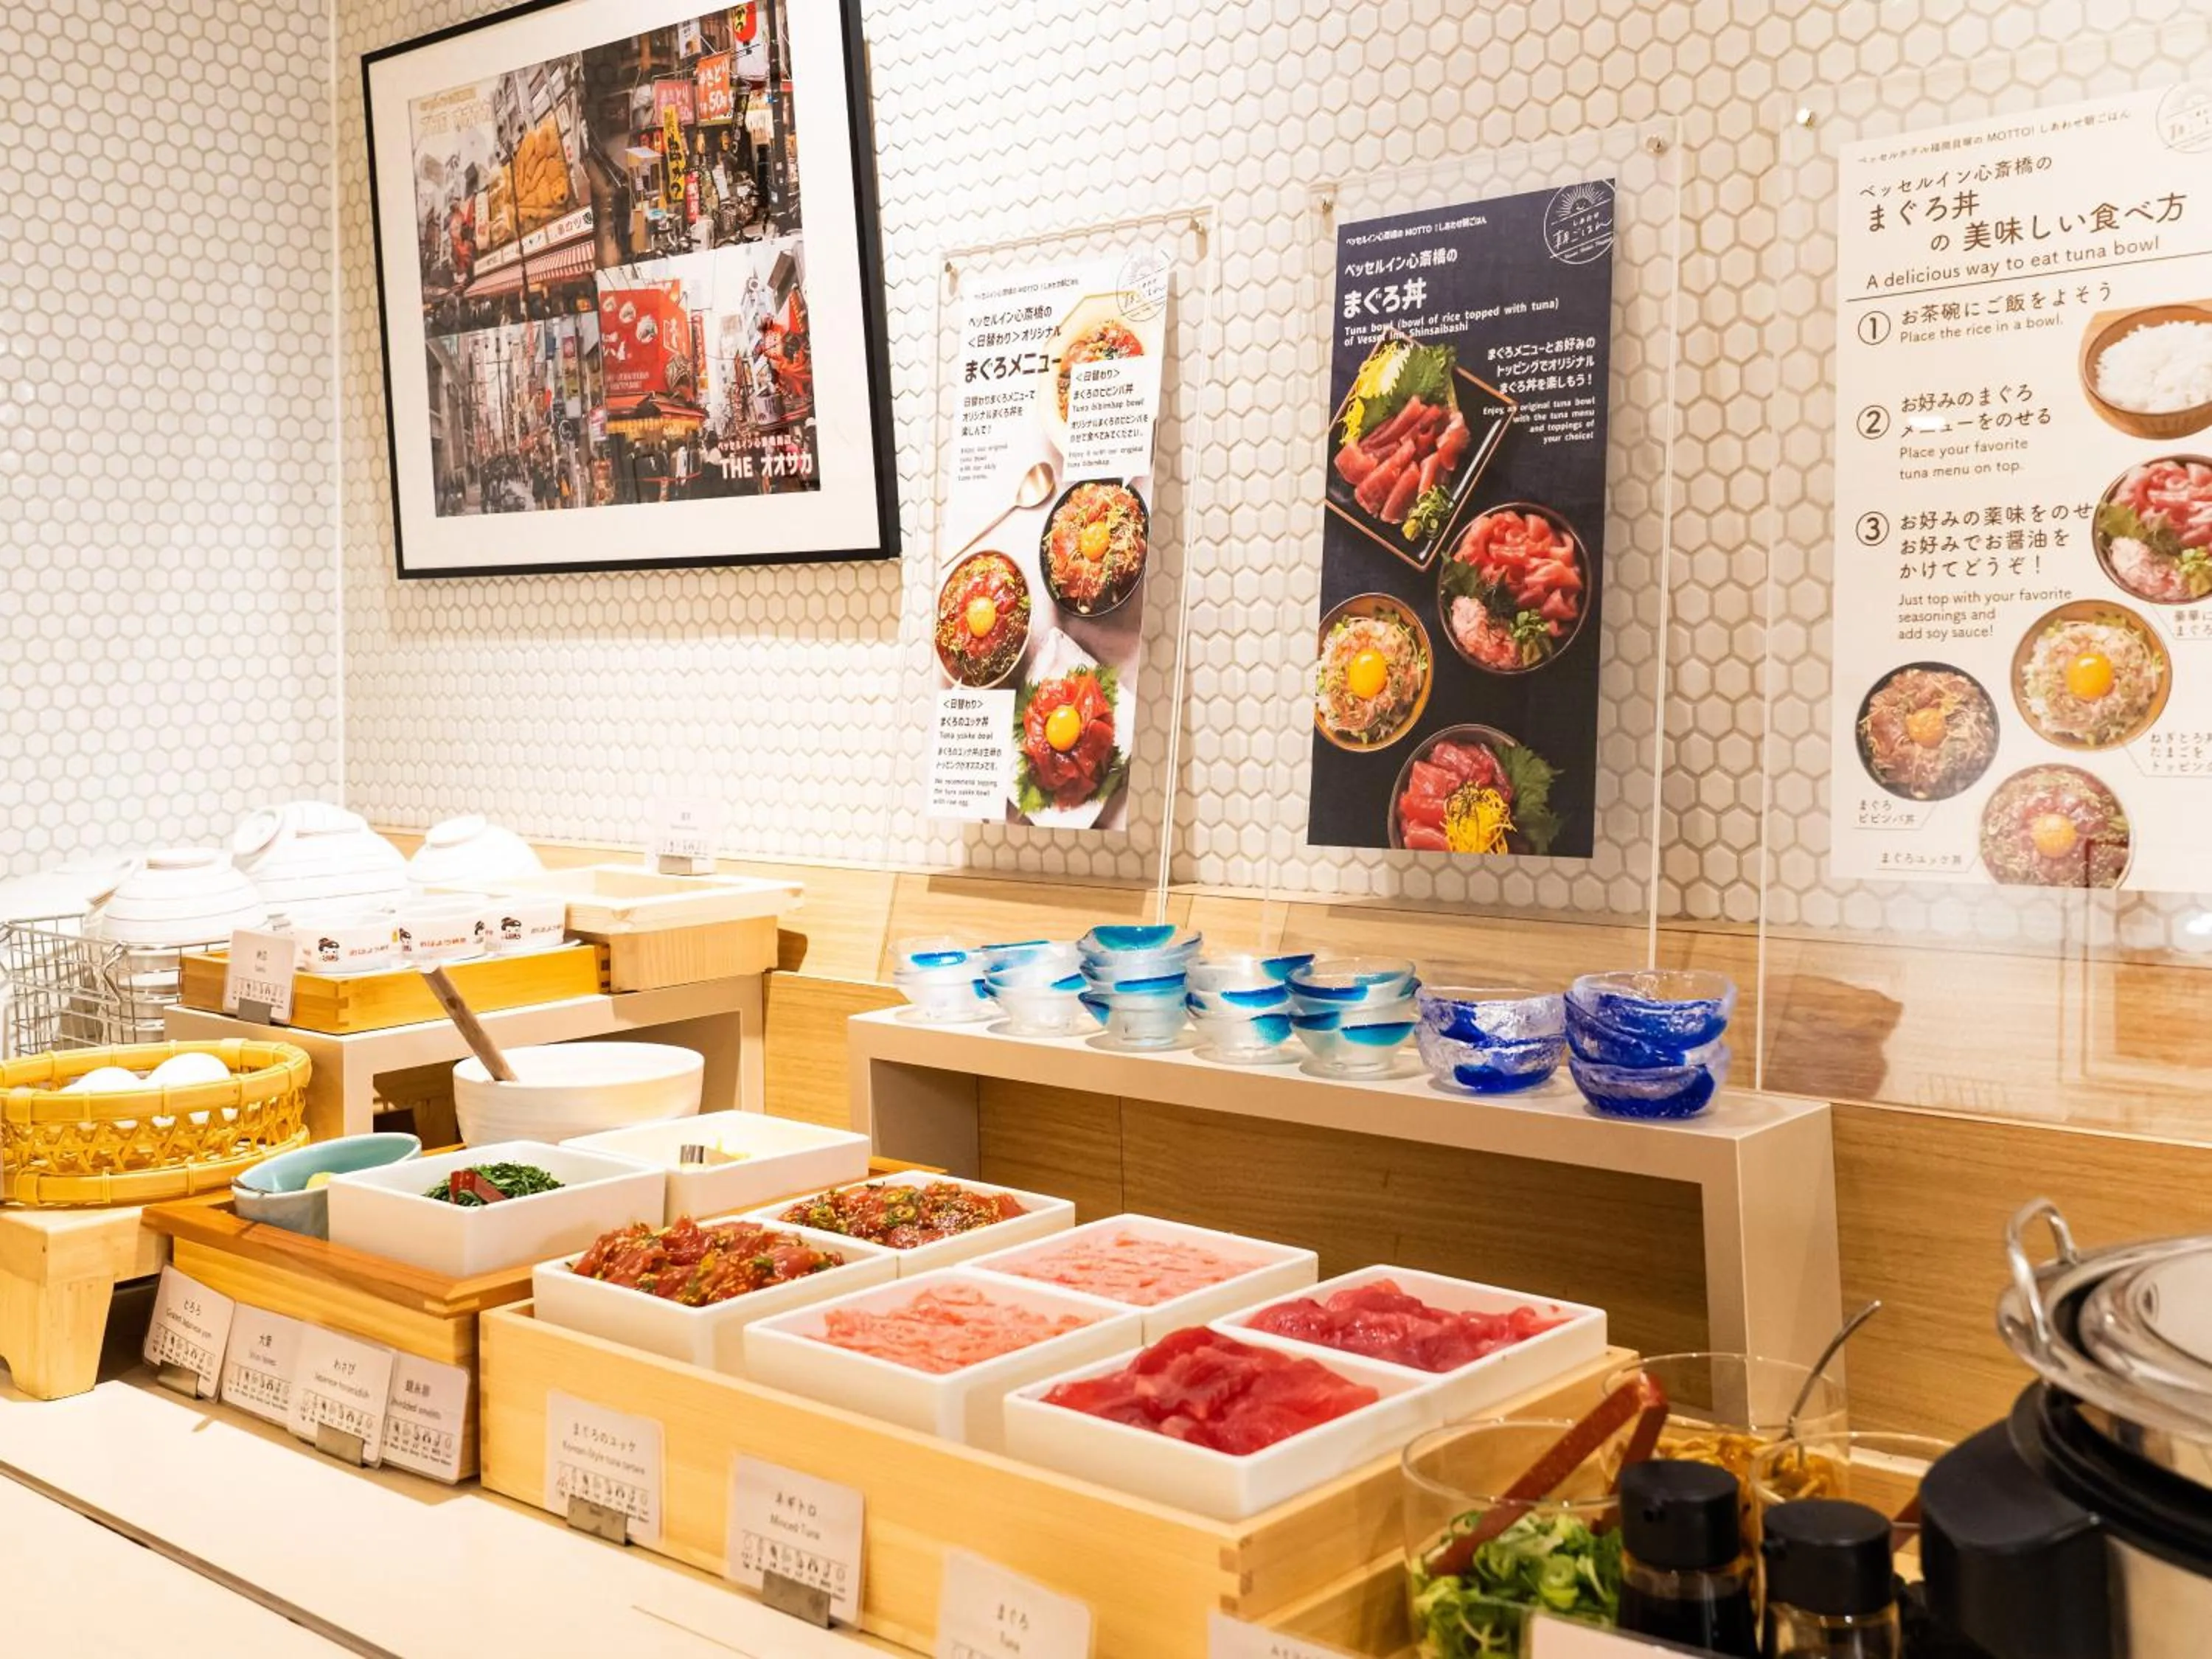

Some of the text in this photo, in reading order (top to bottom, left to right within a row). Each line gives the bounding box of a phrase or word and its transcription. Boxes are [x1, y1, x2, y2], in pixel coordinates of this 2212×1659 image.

[1859, 155, 2053, 198] ベッセルイン心斎橋の
[1868, 189, 1980, 233] まぐろ丼
[1344, 247, 1458, 277] ベッセルイン心斎橋の
[1866, 235, 2159, 289] A delicious way to eat tuna bowl
[1343, 276, 1427, 319] まぐろ丼
[1901, 282, 2111, 325] お茶碗にご飯をよそう
[1345, 297, 1559, 336] Tuna bowl (bowl of rice topped with tuna)
[1900, 313, 2064, 343] Place the rice in a bowl.
[1344, 336, 1354, 347] of
[1409, 321, 1468, 338] Shinsaibashi
[1487, 336, 1596, 361] まぐろメニューとお好みの
[965, 353, 1062, 383] まぐろメニュー
[1497, 355, 1595, 378] トッピングでオリジナル
[1483, 406, 1505, 416] Enjoy
[1520, 400, 1550, 412] original
[1553, 399, 1571, 408] tuna
[1575, 396, 1595, 406] bowl
[1901, 383, 2034, 413] お好みのまぐろ
[1513, 408, 1595, 423] with the tuna menu
[1529, 419, 1595, 433] and toppings of
[1543, 434, 1561, 445] your
[1899, 439, 2028, 459] Place your favorite
[720, 451, 813, 479] THE オオサカ
[1899, 469, 1928, 480] tuna
[1933, 467, 1969, 477] menu
[1974, 464, 1992, 474] on
[1900, 504, 2093, 531] お好みの薬味をのせ
[1900, 529, 2070, 554] お好みでお醤油を
[1899, 588, 2073, 608] Just top with your favorite
[1899, 608, 1995, 625] seasonings and
[1899, 625, 1994, 641] add soy sauce!
[1859, 799, 1892, 811] まぐろ
